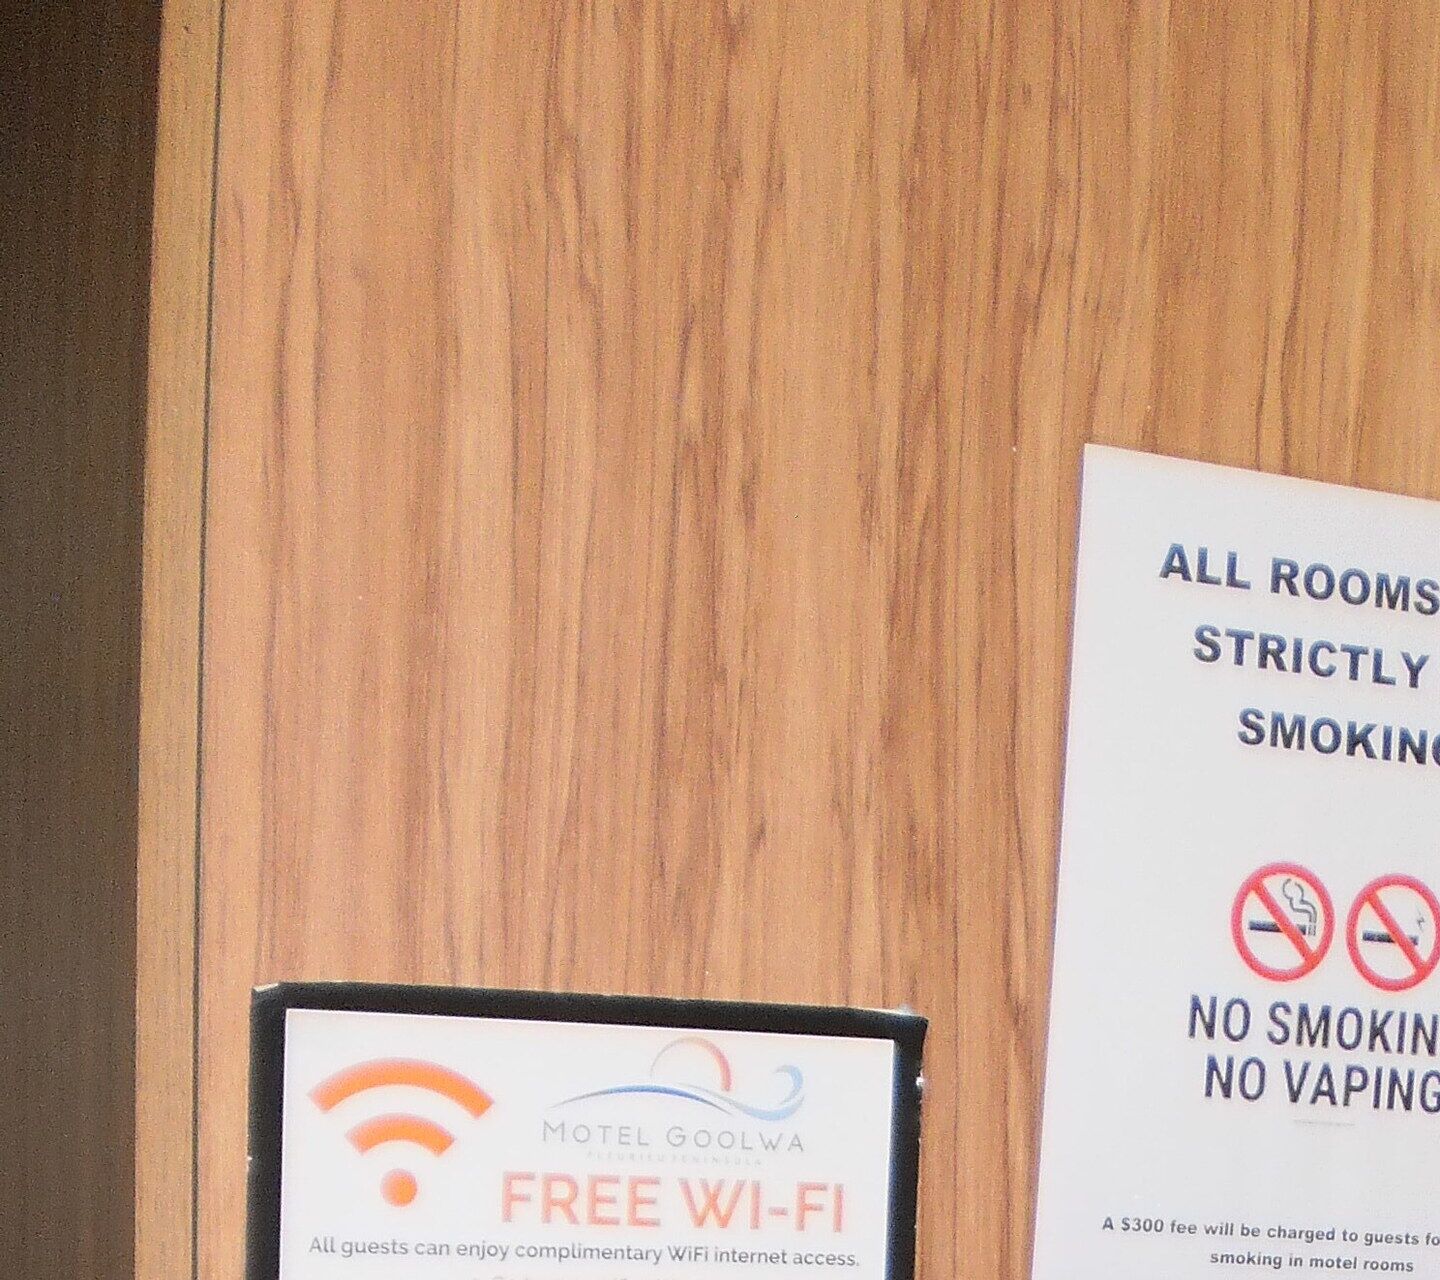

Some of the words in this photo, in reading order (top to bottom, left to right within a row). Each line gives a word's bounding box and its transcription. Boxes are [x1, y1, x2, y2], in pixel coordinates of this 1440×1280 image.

[1159, 543, 1251, 590] ALL
[1270, 557, 1440, 616] ROOMS
[1192, 624, 1430, 690] STRICTLY
[1188, 994, 1251, 1042] NO
[1204, 1054, 1266, 1101] NO
[501, 1170, 661, 1228] FREE
[677, 1177, 844, 1233] WI-FI
[309, 1236, 335, 1254] All
[341, 1238, 408, 1257] guests
[414, 1242, 450, 1256] can
[456, 1241, 510, 1262] enjoy
[515, 1241, 662, 1265] complimentary
[667, 1245, 709, 1262] WiFi
[714, 1246, 787, 1265] internet
[792, 1251, 860, 1267] access.
[1102, 1216, 1114, 1231] A
[1121, 1217, 1164, 1235] $300
[1170, 1219, 1198, 1235] fee
[1204, 1221, 1234, 1237] will
[1240, 1222, 1260, 1239] be
[1267, 1225, 1335, 1244] charged
[1342, 1228, 1359, 1243] to
[1364, 1230, 1419, 1247] guests
[1210, 1251, 1282, 1269] smoking
[1288, 1253, 1304, 1268] in
[1309, 1255, 1357, 1270] motel
[1363, 1258, 1414, 1273] rooms
